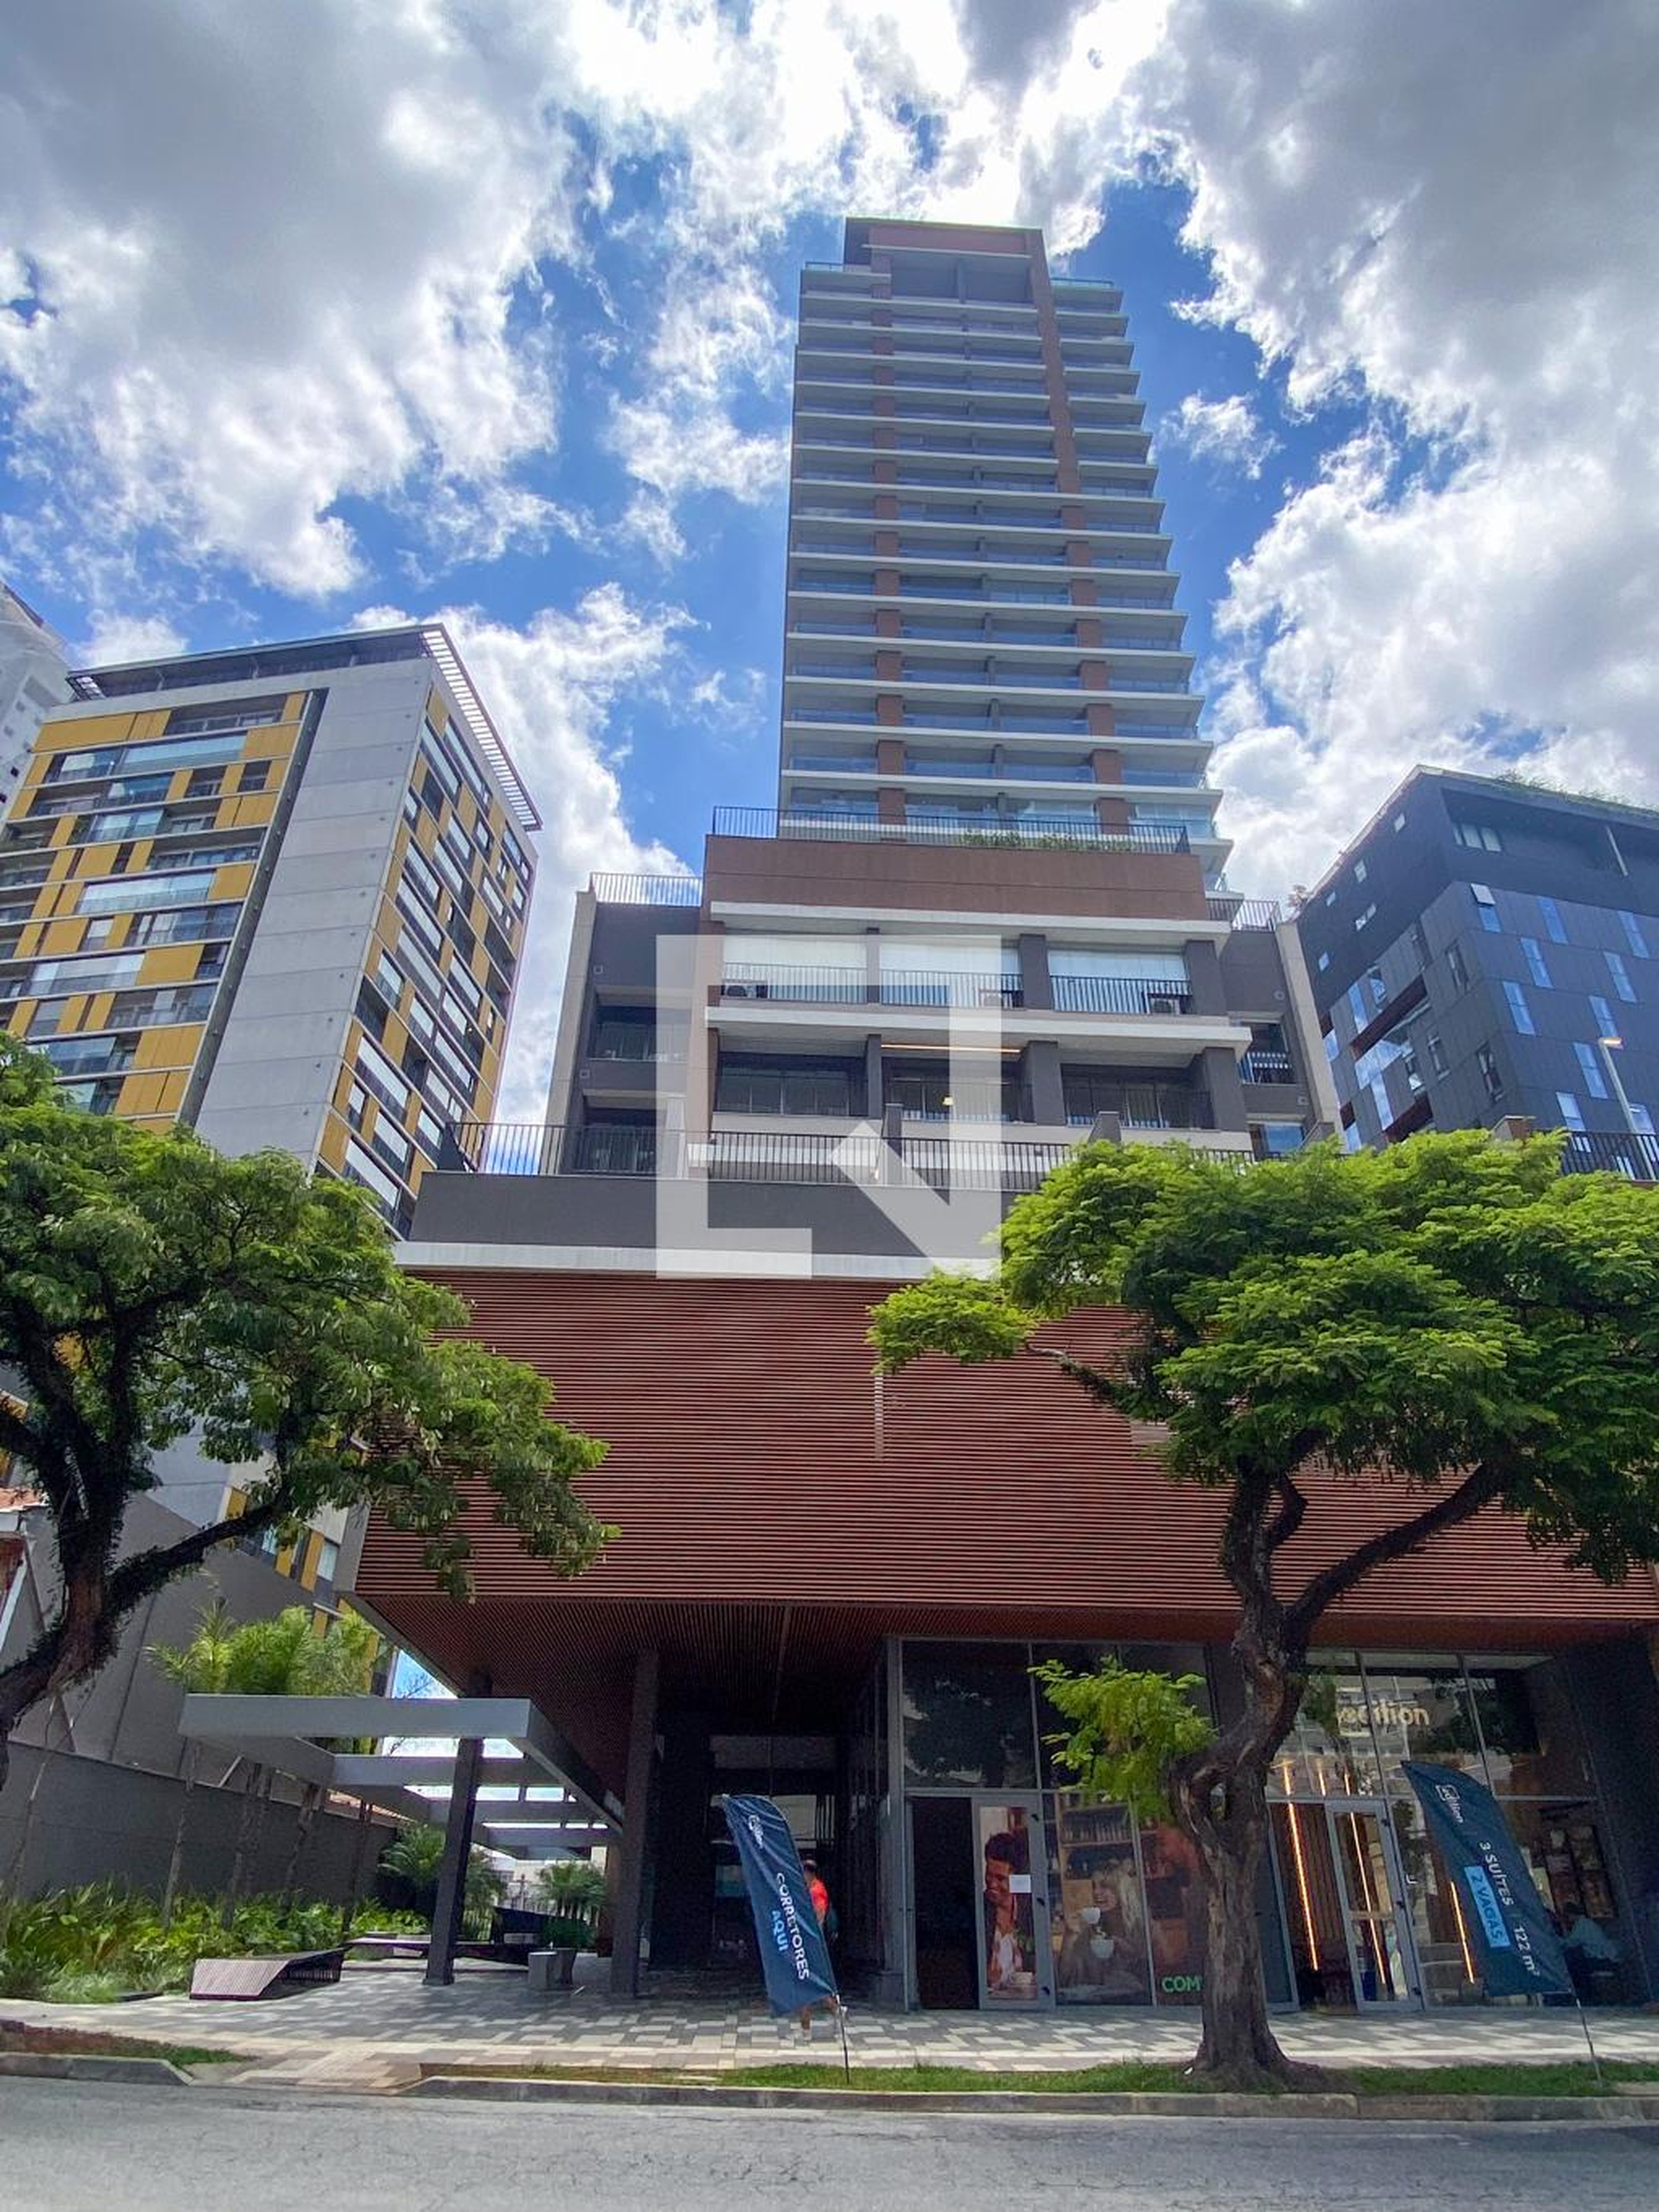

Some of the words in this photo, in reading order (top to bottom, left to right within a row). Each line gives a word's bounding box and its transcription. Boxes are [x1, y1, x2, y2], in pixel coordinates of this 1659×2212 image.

[772, 1910, 789, 1951] AQUI
[777, 1872, 809, 1980] CORRETORES
[1471, 1874, 1483, 1884] 2
[1477, 1886, 1503, 1940] VAGAS
[1479, 1842, 1491, 1851] 3
[1513, 1925, 1531, 1951] 122
